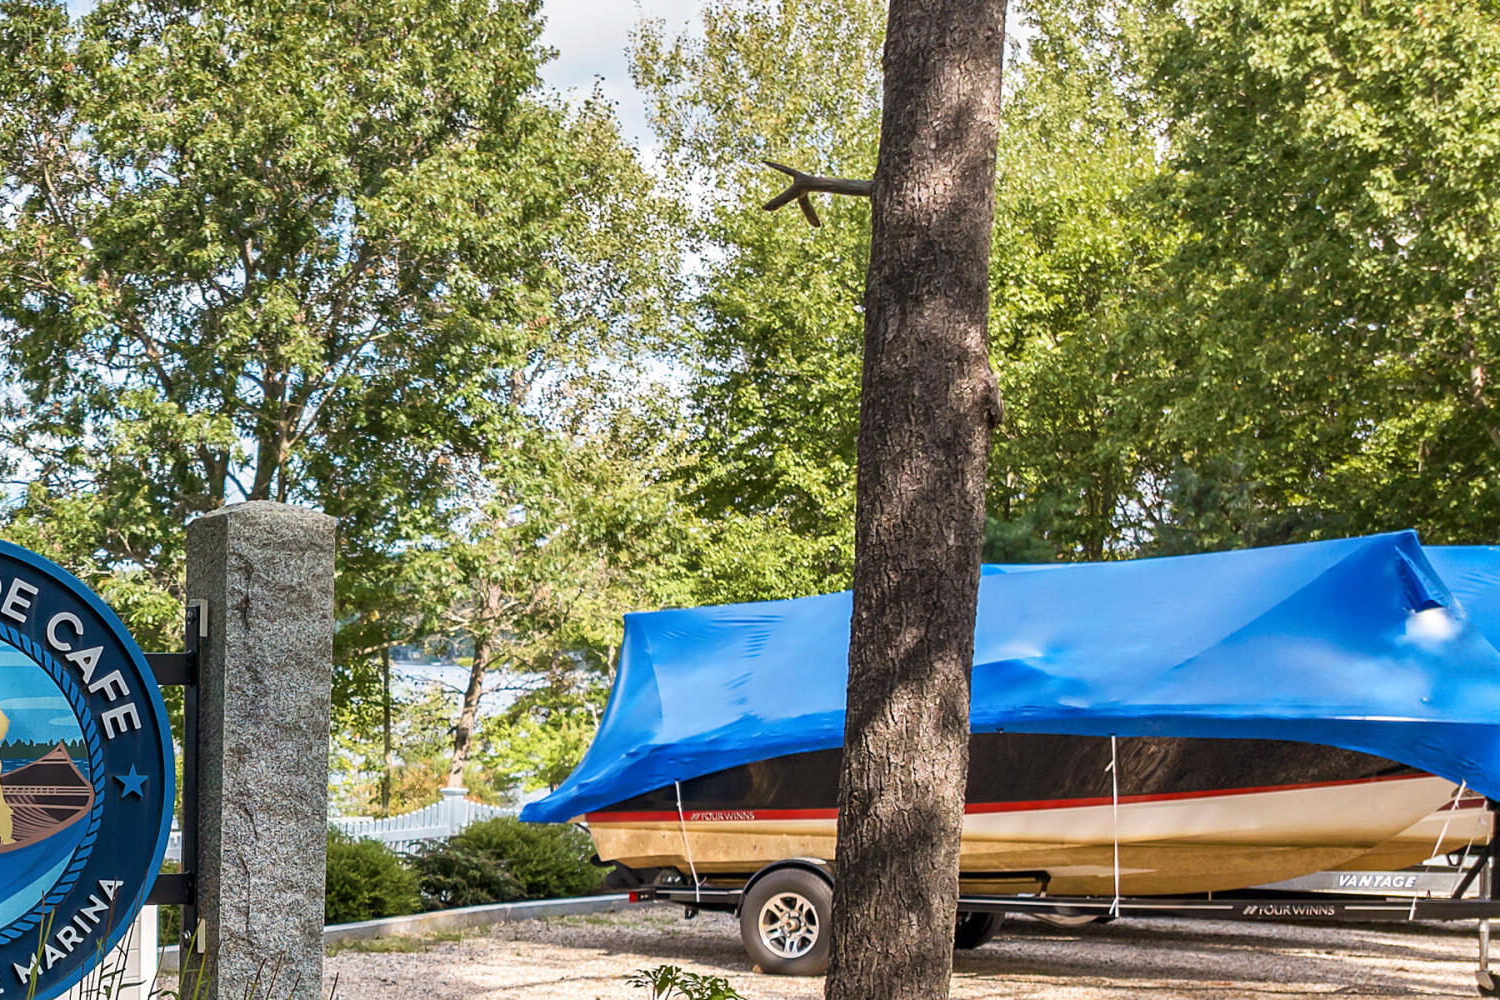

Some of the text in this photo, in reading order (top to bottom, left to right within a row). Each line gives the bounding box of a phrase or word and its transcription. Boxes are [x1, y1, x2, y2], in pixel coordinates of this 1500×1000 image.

[46, 611, 142, 740] CAFE
[701, 810, 755, 821] FOUR WINNS
[1338, 875, 1417, 888] VANTAGE
[1259, 905, 1335, 916] FOUR WINNS
[13, 879, 124, 984] MARINA
